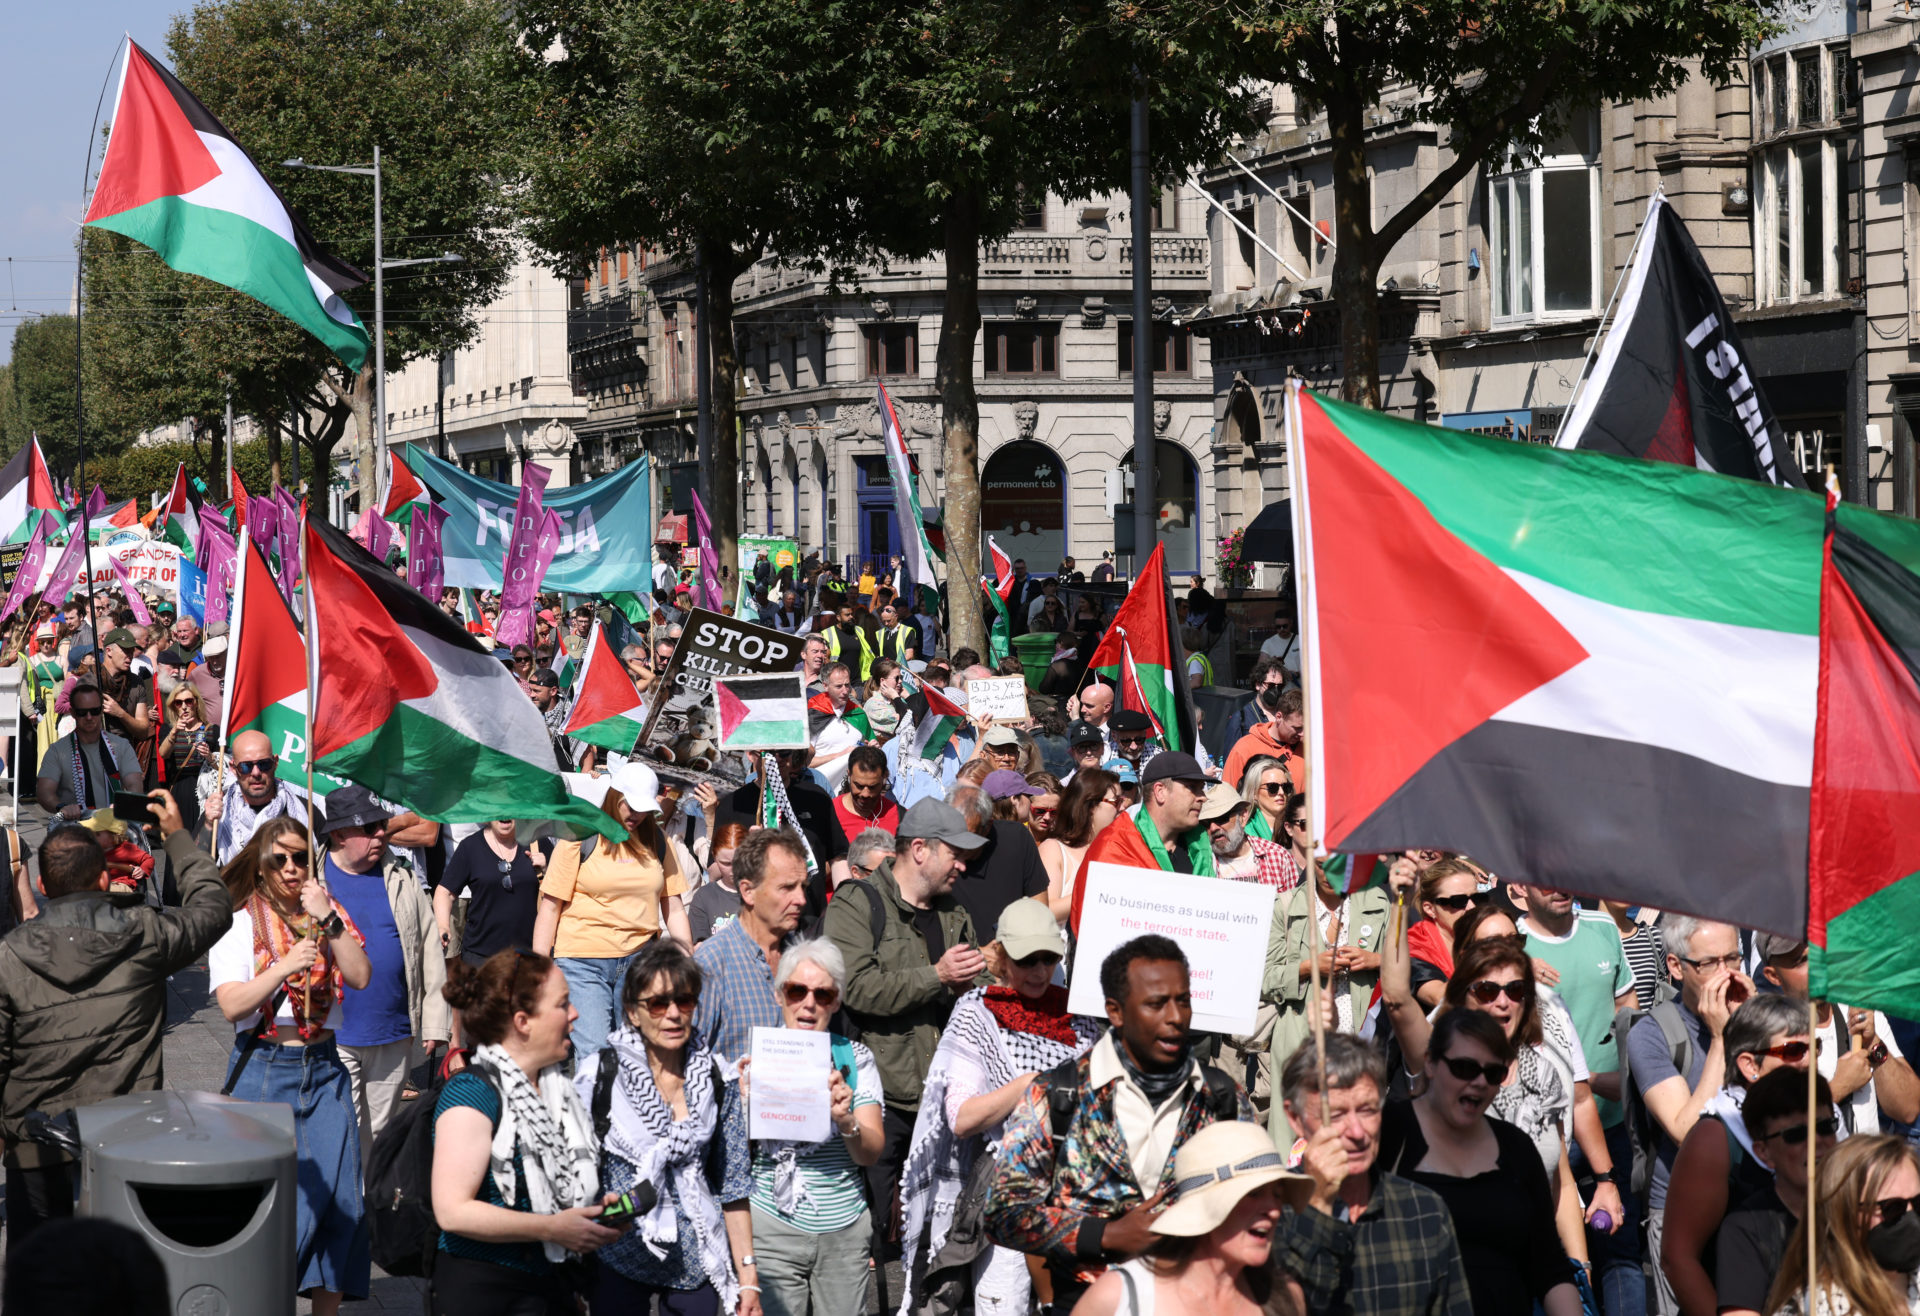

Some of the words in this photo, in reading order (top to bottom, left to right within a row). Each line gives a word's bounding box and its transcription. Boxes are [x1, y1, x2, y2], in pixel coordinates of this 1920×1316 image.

[987, 481, 1039, 491] permanent
[1041, 480, 1056, 489] tsb
[119, 549, 179, 563] GRANDFA
[694, 622, 789, 665] STOP
[971, 682, 1000, 693] BDS
[1003, 681, 1023, 698] YES
[1098, 892, 1117, 906] No
[1120, 896, 1175, 915] business
[1178, 906, 1193, 917] as
[1196, 908, 1229, 922] usual
[1232, 913, 1259, 926] with
[1121, 917, 1142, 930] the
[1144, 921, 1193, 938] terrorist
[1196, 929, 1230, 943] state.
[1190, 970, 1214, 981] ael!
[1190, 990, 1214, 1001] ael!
